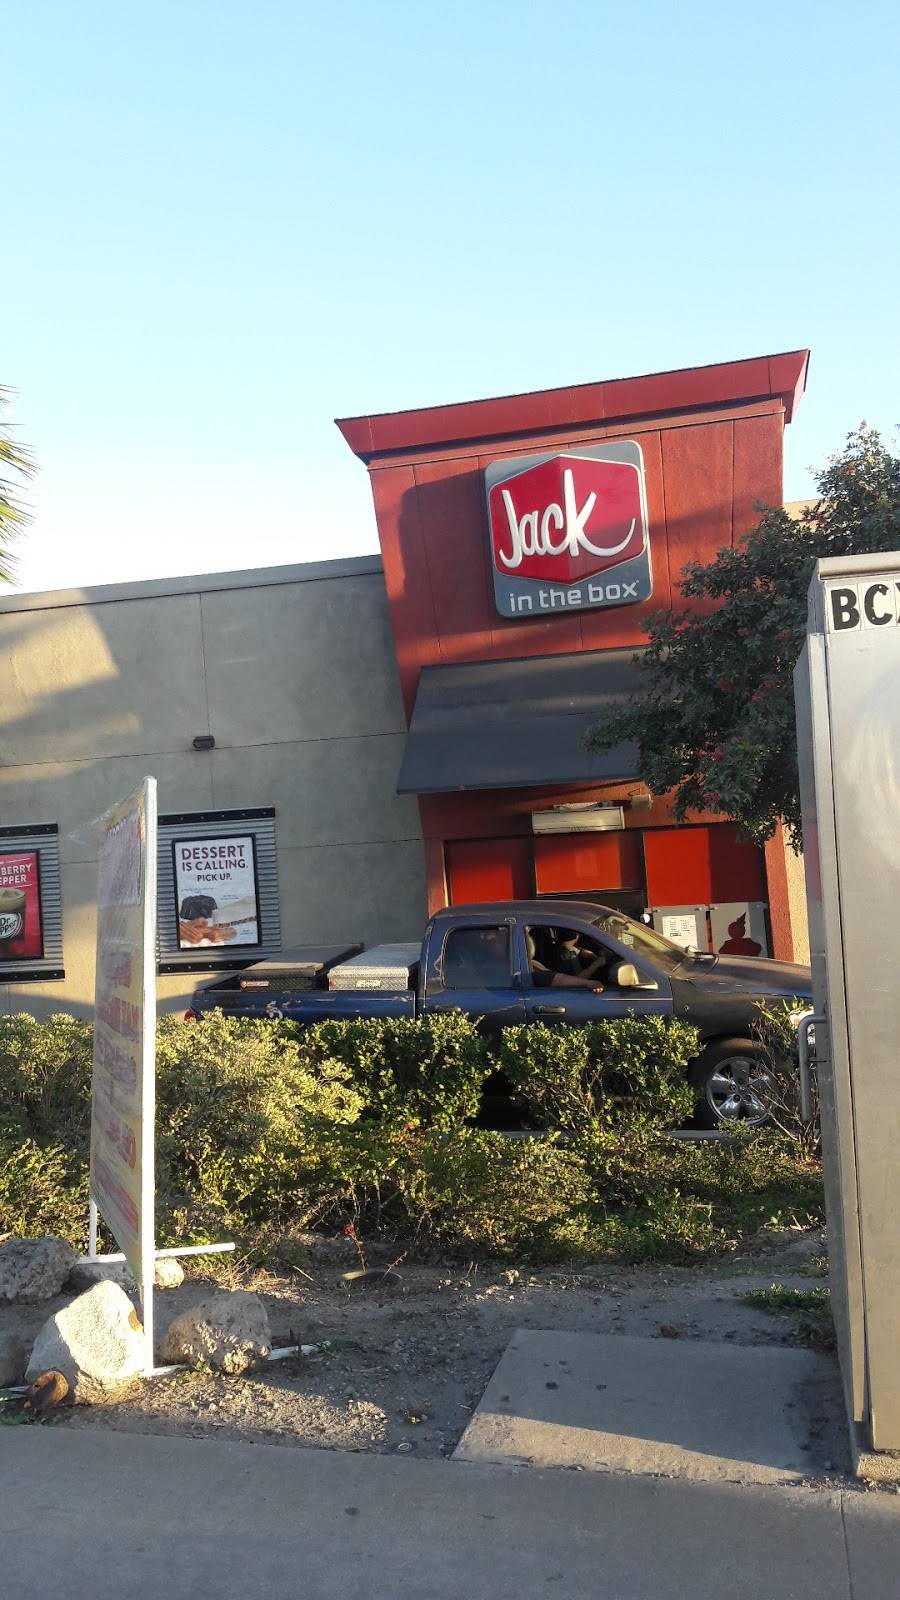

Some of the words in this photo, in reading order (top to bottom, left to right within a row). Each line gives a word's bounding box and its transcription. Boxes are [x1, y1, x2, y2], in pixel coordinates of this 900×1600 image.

[499, 468, 636, 569] Jack
[509, 593, 533, 612] in
[538, 588, 582, 609] the
[588, 582, 638, 603] box
[181, 844, 245, 860] DESSERT
[1, 863, 32, 875] BERRY
[182, 861, 193, 872] IS
[195, 858, 249, 871] CALLING.
[196, 874, 218, 882] PICK
[219, 872, 233, 881] UP.
